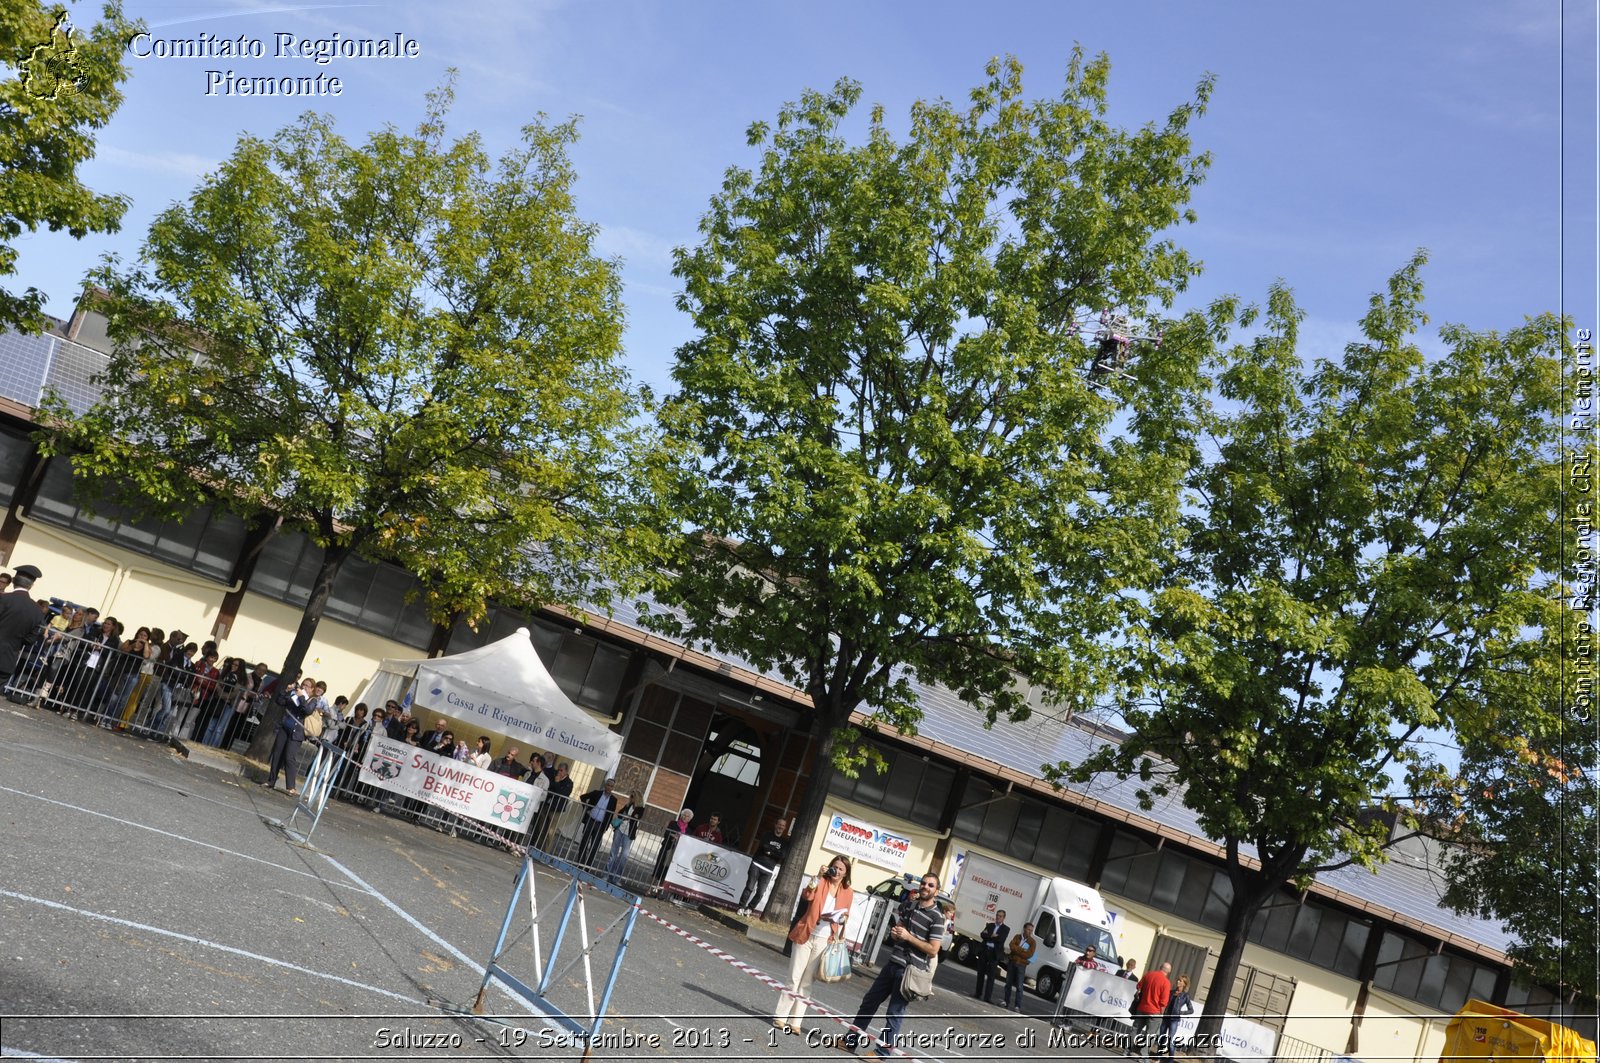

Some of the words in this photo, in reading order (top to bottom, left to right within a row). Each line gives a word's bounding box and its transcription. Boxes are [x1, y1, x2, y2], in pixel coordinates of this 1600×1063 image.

[447, 691, 474, 711] Cassa
[478, 703, 488, 715] di
[491, 708, 542, 734] Risparmio
[545, 727, 556, 740] di
[559, 731, 595, 753] Saluzzo
[411, 754, 495, 793] SALUMIFICIO
[423, 776, 474, 804] BENESE
[830, 829, 875, 849] PNEUMATICI
[879, 845, 905, 858] SERVIZI
[694, 859, 728, 878] BRIZIO
[989, 893, 999, 903] 118
[1100, 989, 1128, 1009] Cassa
